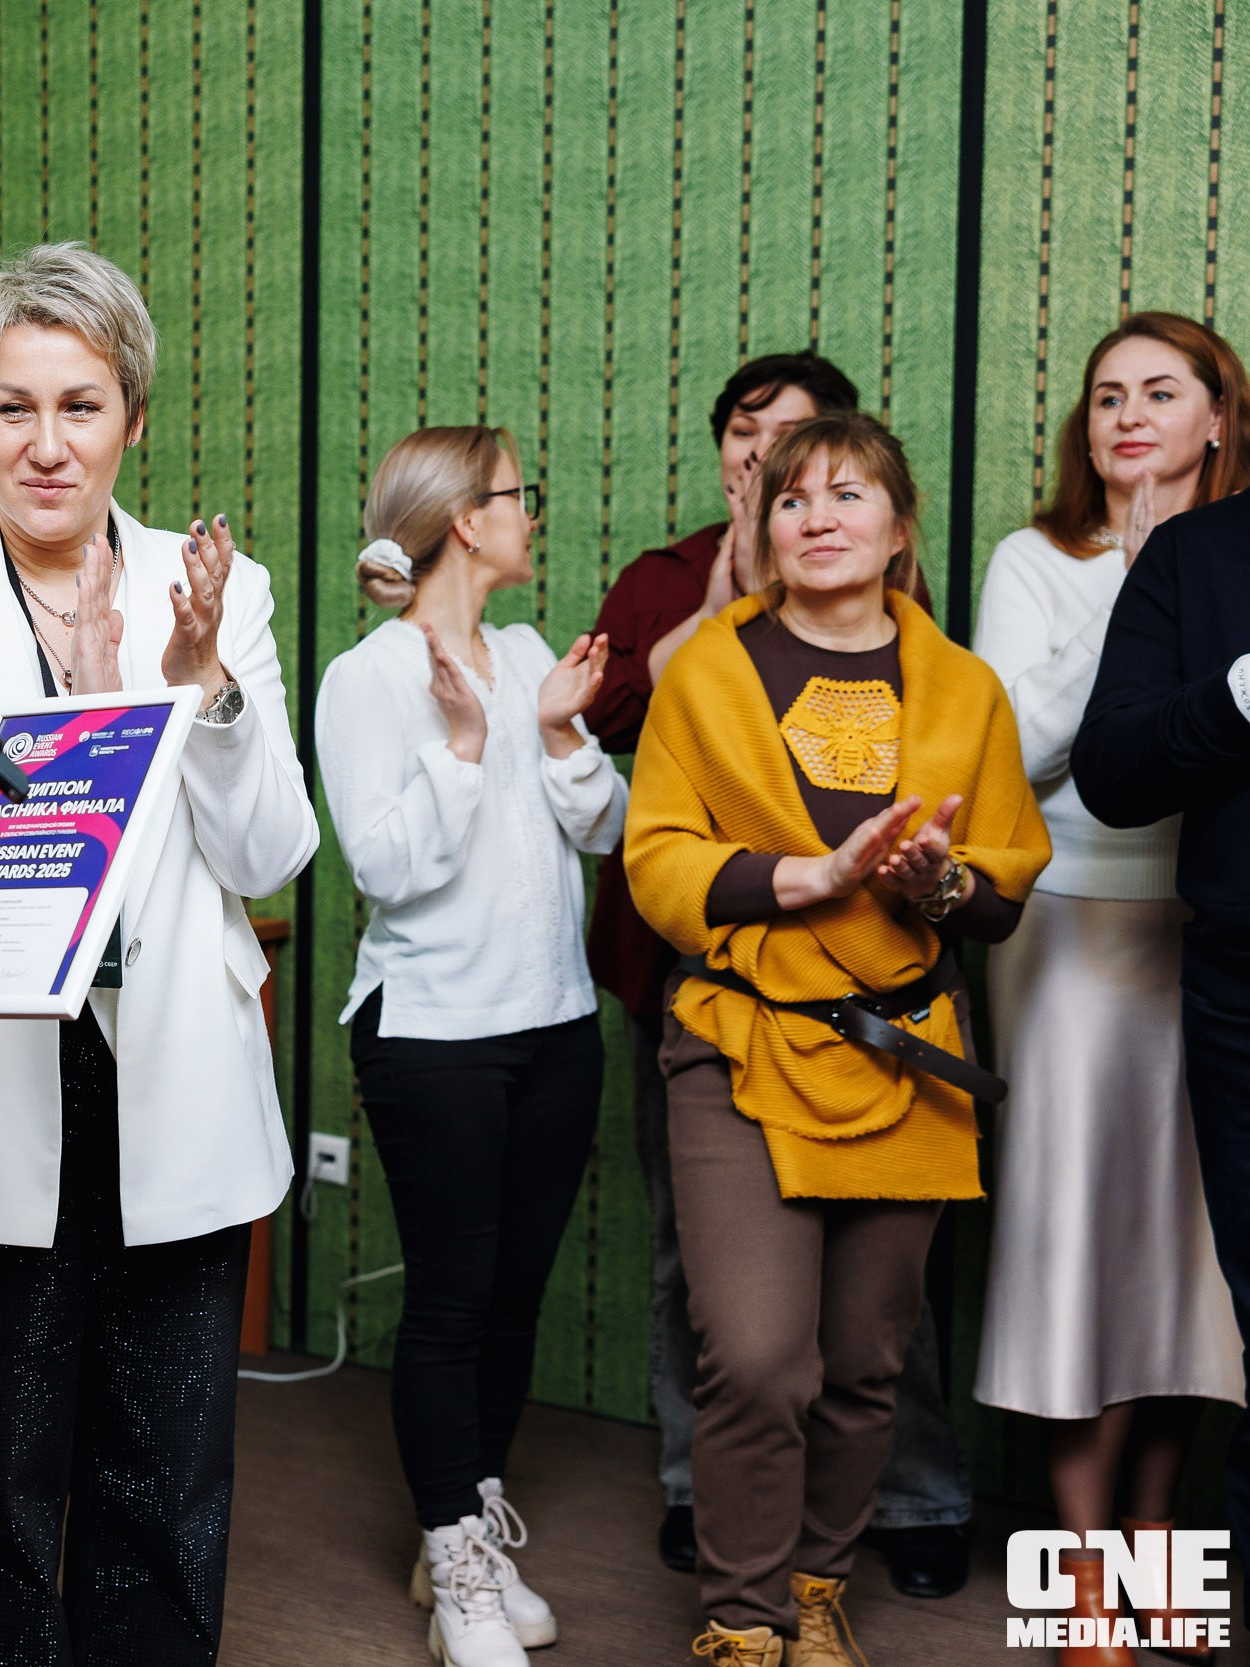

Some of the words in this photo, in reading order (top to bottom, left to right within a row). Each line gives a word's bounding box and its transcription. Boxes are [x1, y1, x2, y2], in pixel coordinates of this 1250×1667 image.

[36, 733, 64, 742] RUSSIAN
[33, 741, 54, 750] EVENT
[30, 749, 57, 758] AWARDS
[60, 798, 125, 814] ФИНАЛА
[38, 842, 85, 859] EVENT
[34, 862, 73, 878] 2025
